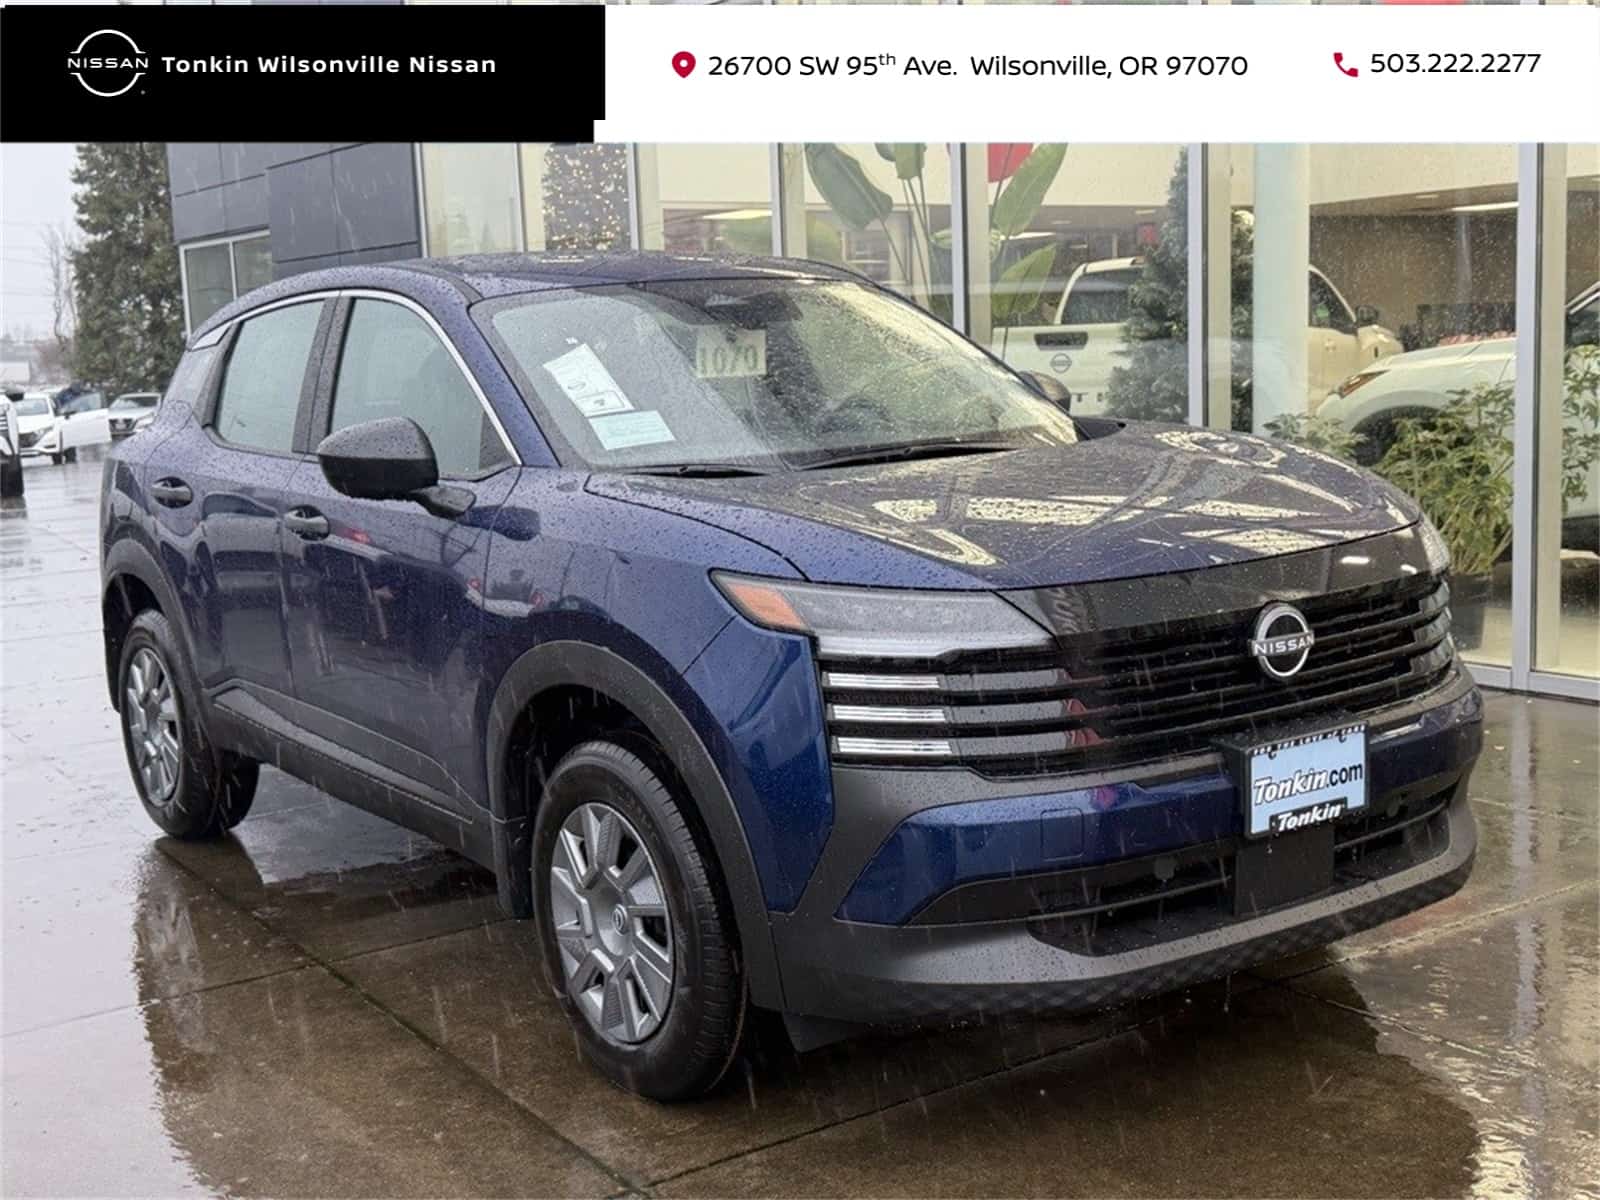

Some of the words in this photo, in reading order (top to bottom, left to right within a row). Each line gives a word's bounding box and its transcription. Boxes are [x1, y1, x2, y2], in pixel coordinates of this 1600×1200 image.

[1254, 635, 1314, 655] NISSAN
[1253, 763, 1363, 806] Tonkin.com
[1278, 803, 1342, 831] Tonkin
